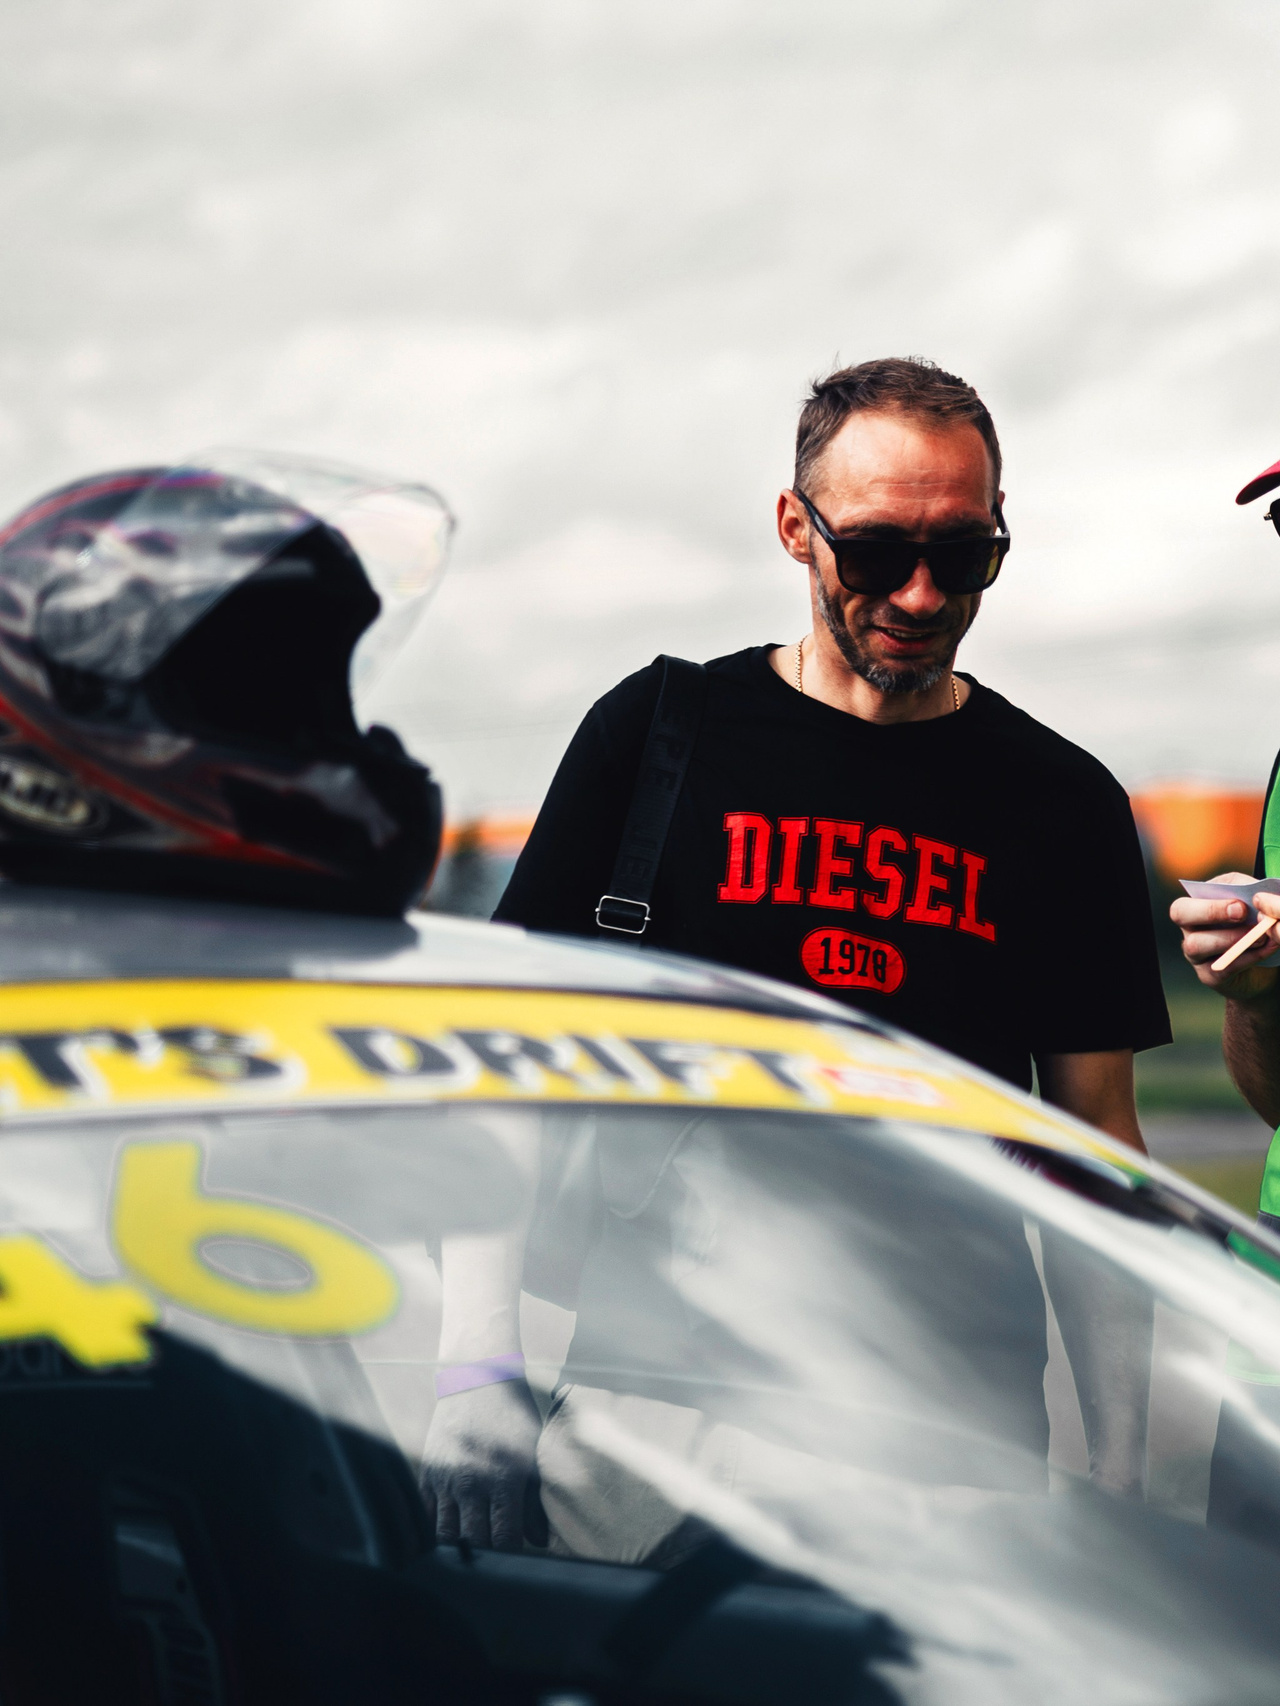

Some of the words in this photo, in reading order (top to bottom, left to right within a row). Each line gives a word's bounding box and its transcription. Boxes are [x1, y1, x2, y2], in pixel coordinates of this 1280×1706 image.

[717, 811, 998, 945] DIESEL
[818, 936, 888, 984] 1978
[0, 1025, 306, 1103] T'S
[325, 1025, 832, 1107] DRIFT
